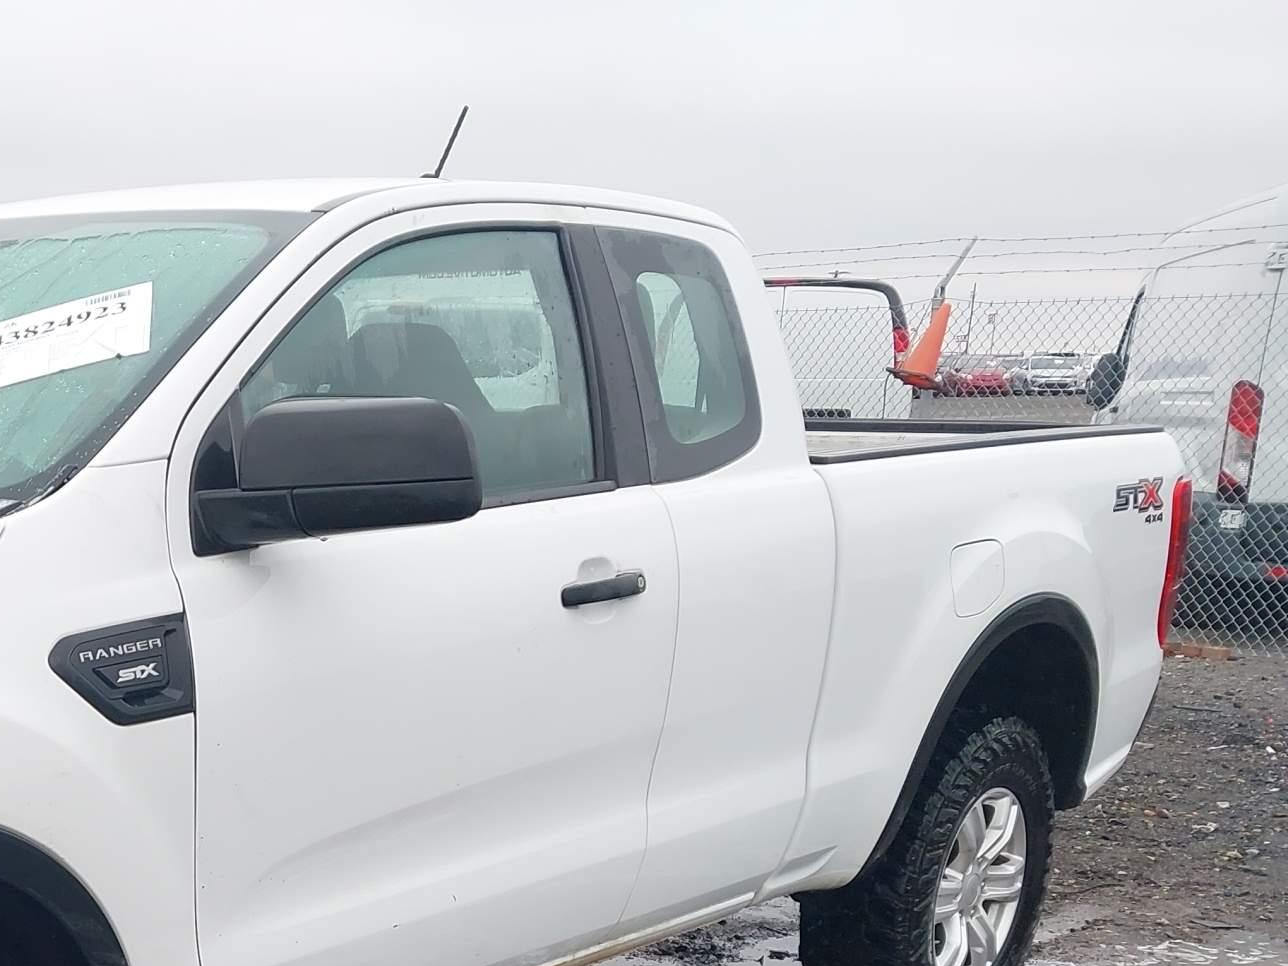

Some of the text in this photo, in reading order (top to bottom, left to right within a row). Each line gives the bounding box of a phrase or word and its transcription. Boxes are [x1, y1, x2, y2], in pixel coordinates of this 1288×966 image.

[1113, 476, 1164, 513] STX
[79, 637, 162, 663] RANGER
[117, 662, 160, 683] STX
